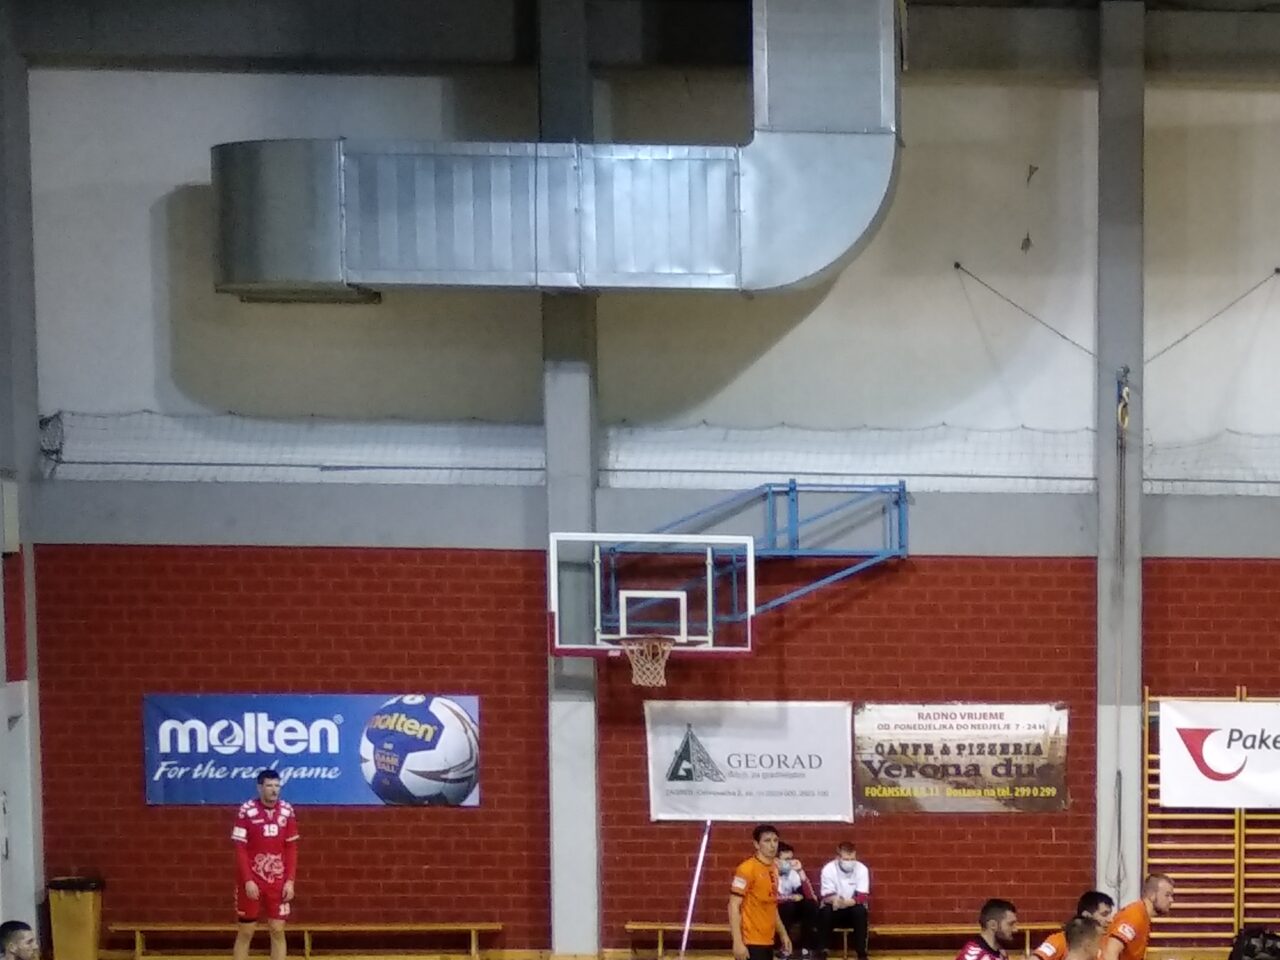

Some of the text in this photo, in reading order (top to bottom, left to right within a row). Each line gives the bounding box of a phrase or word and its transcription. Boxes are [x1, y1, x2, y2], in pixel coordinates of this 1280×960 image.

[917, 712, 1005, 720] RADNO VRIJEME
[158, 712, 340, 755] molten
[875, 743, 934, 757] CAFFE
[956, 743, 1043, 755] PIZZERIA
[726, 753, 823, 769] GEORAD
[154, 760, 190, 781] For
[192, 759, 229, 779] the
[280, 766, 341, 787] game
[861, 759, 982, 780] Verona
[263, 824, 279, 837] 19
